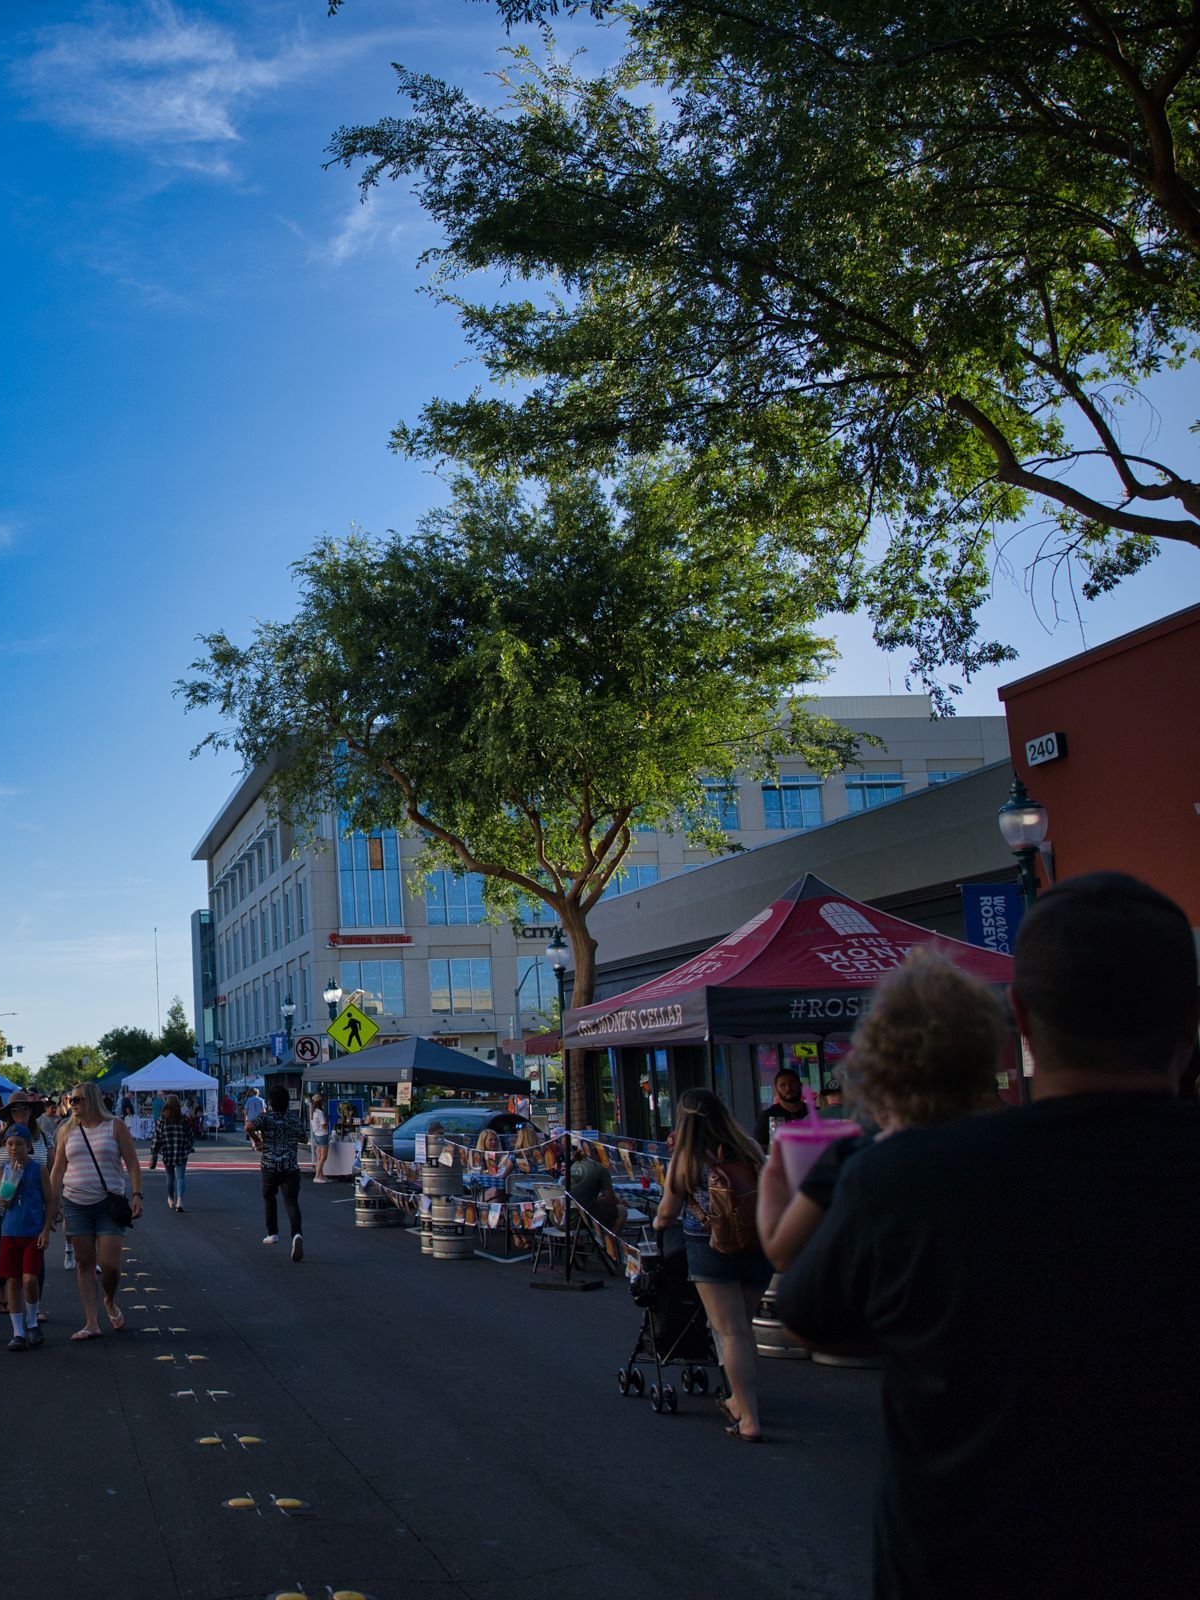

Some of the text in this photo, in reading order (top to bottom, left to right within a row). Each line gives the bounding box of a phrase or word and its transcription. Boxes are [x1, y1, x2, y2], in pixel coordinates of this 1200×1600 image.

[1029, 738, 1055, 761] 240
[995, 916, 1009, 942] are
[846, 937, 892, 947] THE
[596, 1010, 637, 1035] MONK'S
[638, 1004, 682, 1030] CELLAR
